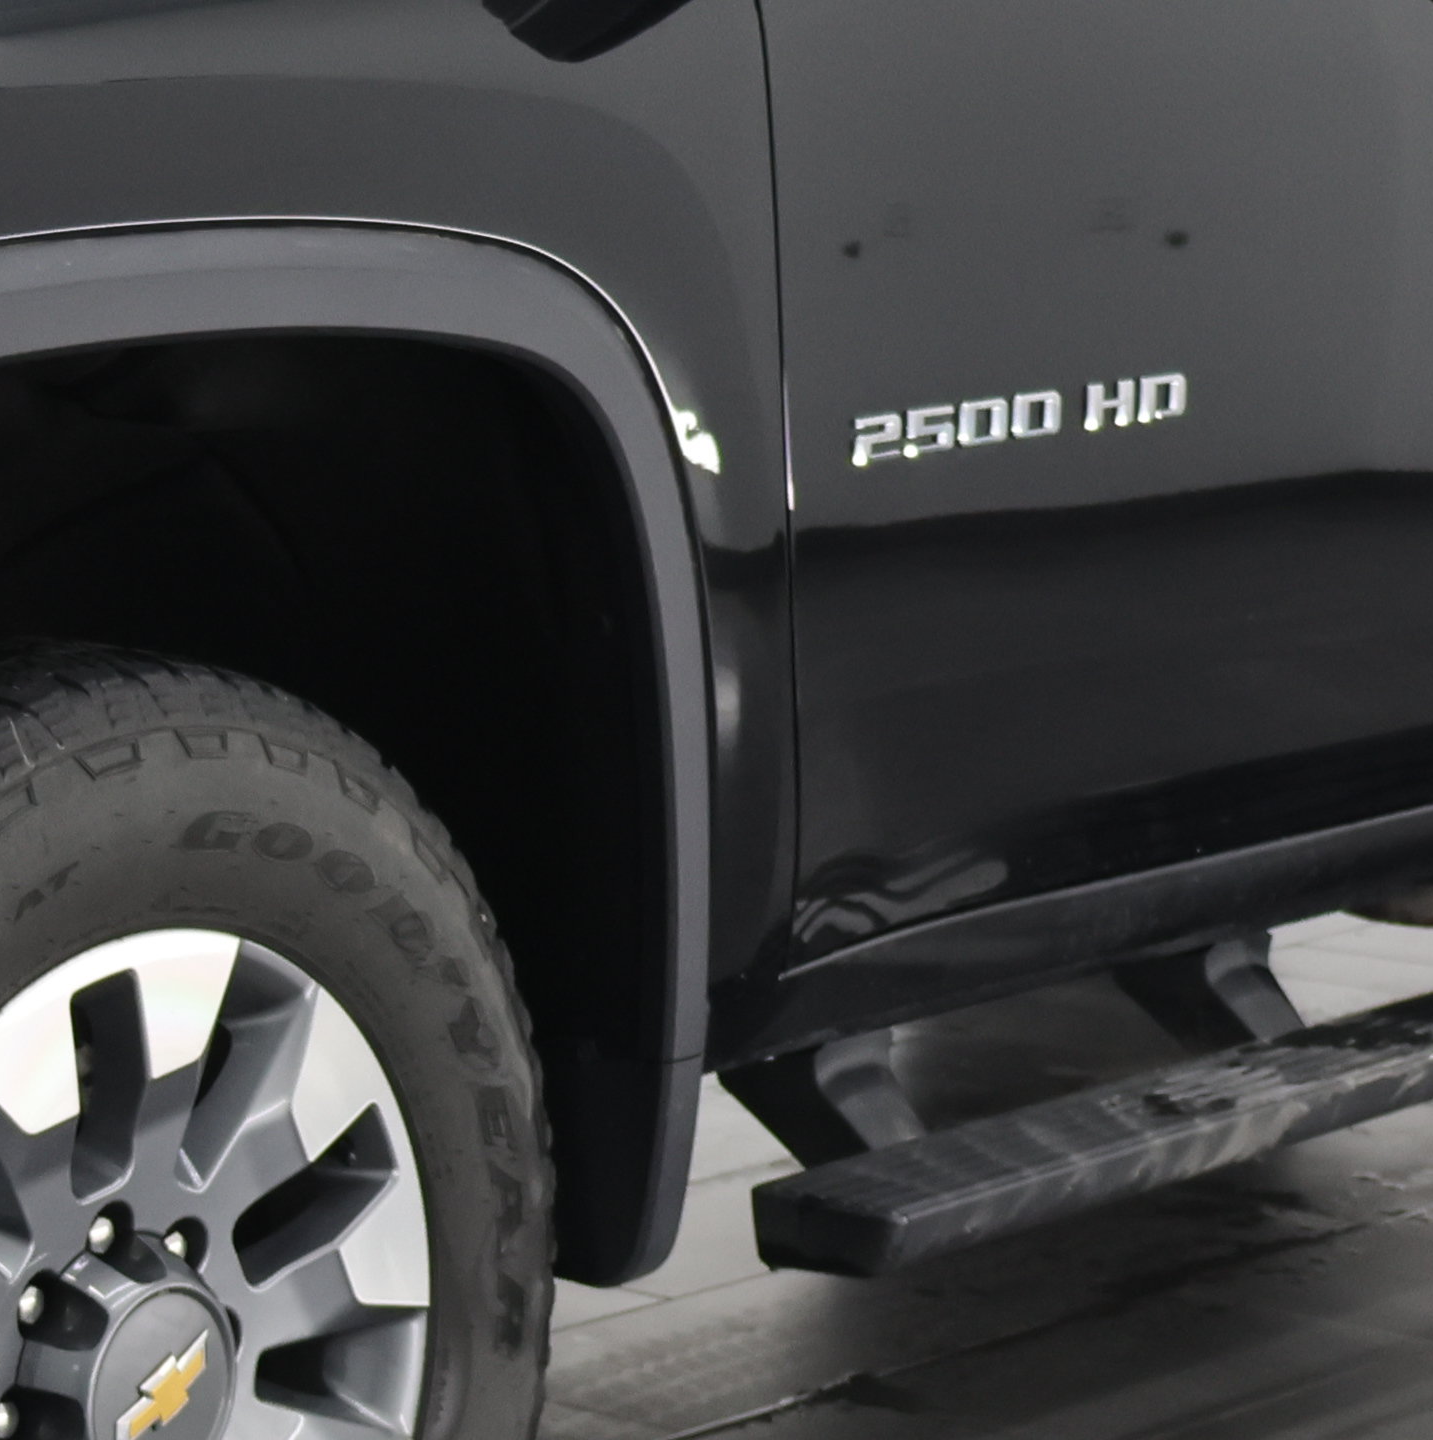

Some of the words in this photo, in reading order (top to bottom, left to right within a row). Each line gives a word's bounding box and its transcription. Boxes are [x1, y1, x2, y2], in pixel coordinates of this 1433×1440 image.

[850, 389, 1061, 466] 2500
[1084, 373, 1187, 431] HD
[178, 811, 528, 1353] GOODYEAR
